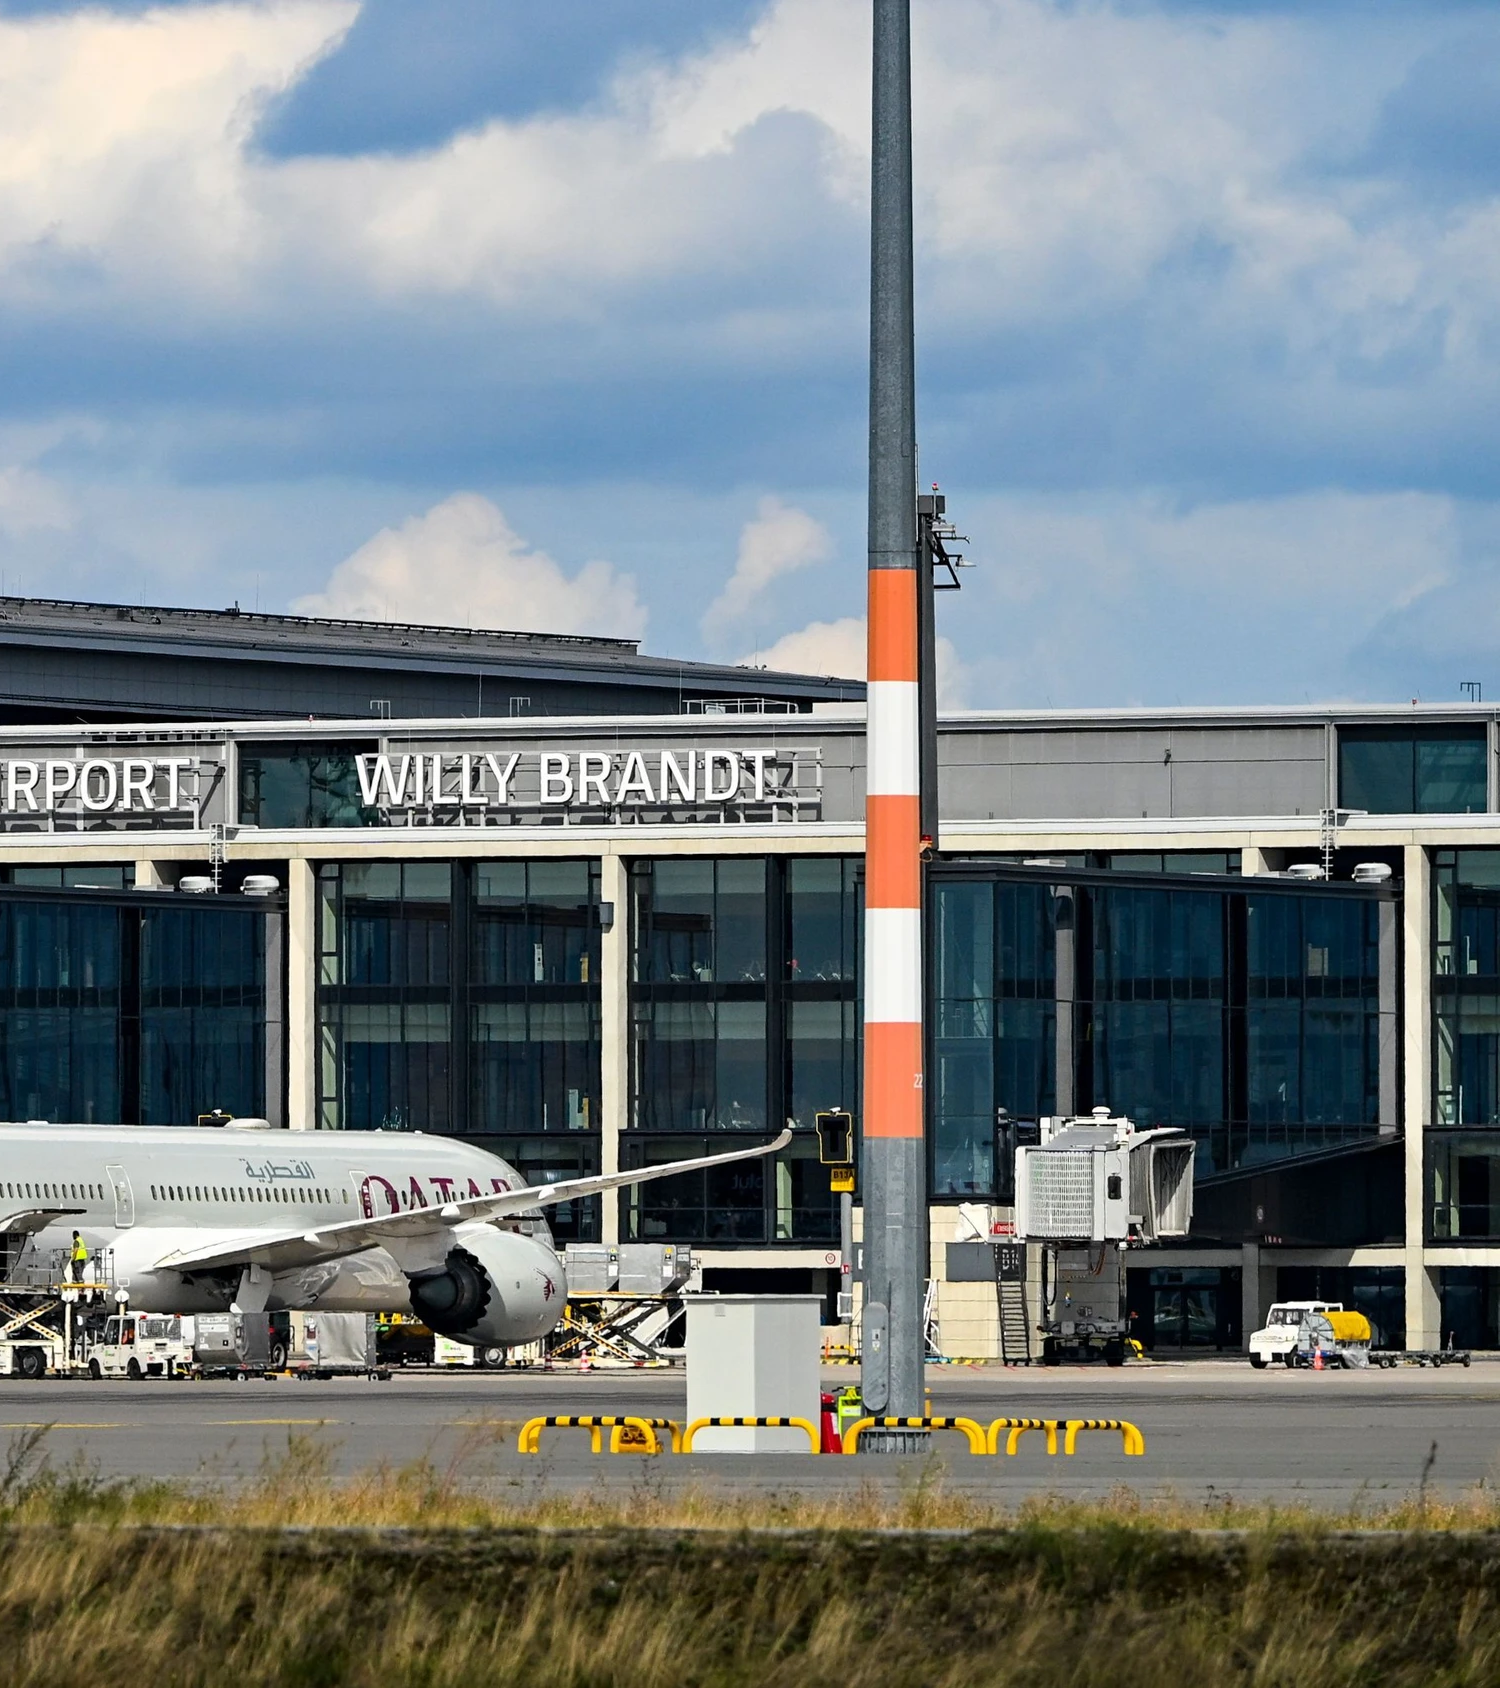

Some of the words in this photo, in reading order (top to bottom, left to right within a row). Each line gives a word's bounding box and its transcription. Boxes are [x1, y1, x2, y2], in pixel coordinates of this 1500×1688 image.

[355, 752, 521, 806] WILLY
[539, 749, 777, 804] BRANDT
[238, 1157, 316, 1184] القطرية
